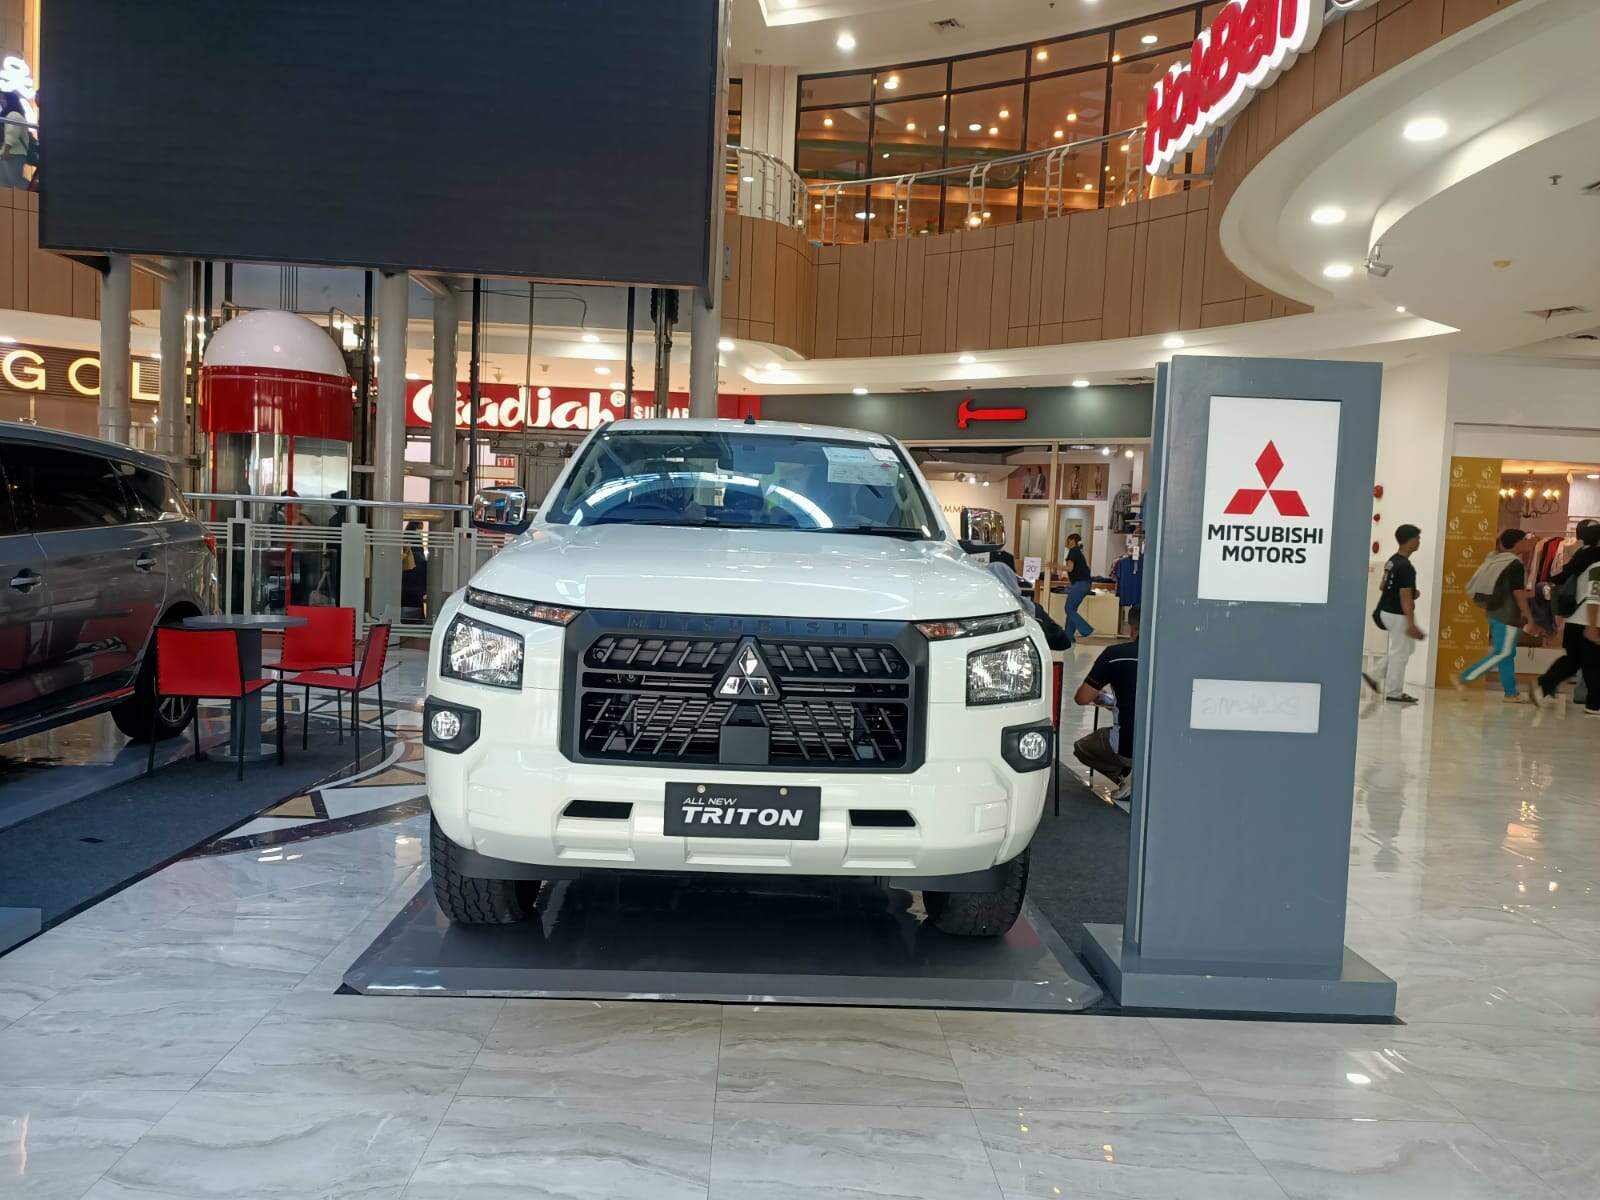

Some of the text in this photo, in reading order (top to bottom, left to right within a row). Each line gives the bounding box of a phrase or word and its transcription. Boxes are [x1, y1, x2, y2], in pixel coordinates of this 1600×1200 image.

[2, 349, 192, 404] GOL
[1207, 523, 1324, 544] MITSUBISHI
[1222, 545, 1307, 564] MOTORS
[626, 614, 870, 636] MITSUBISHI
[683, 797, 738, 806] ALL NEW
[681, 806, 804, 827] TRITON
